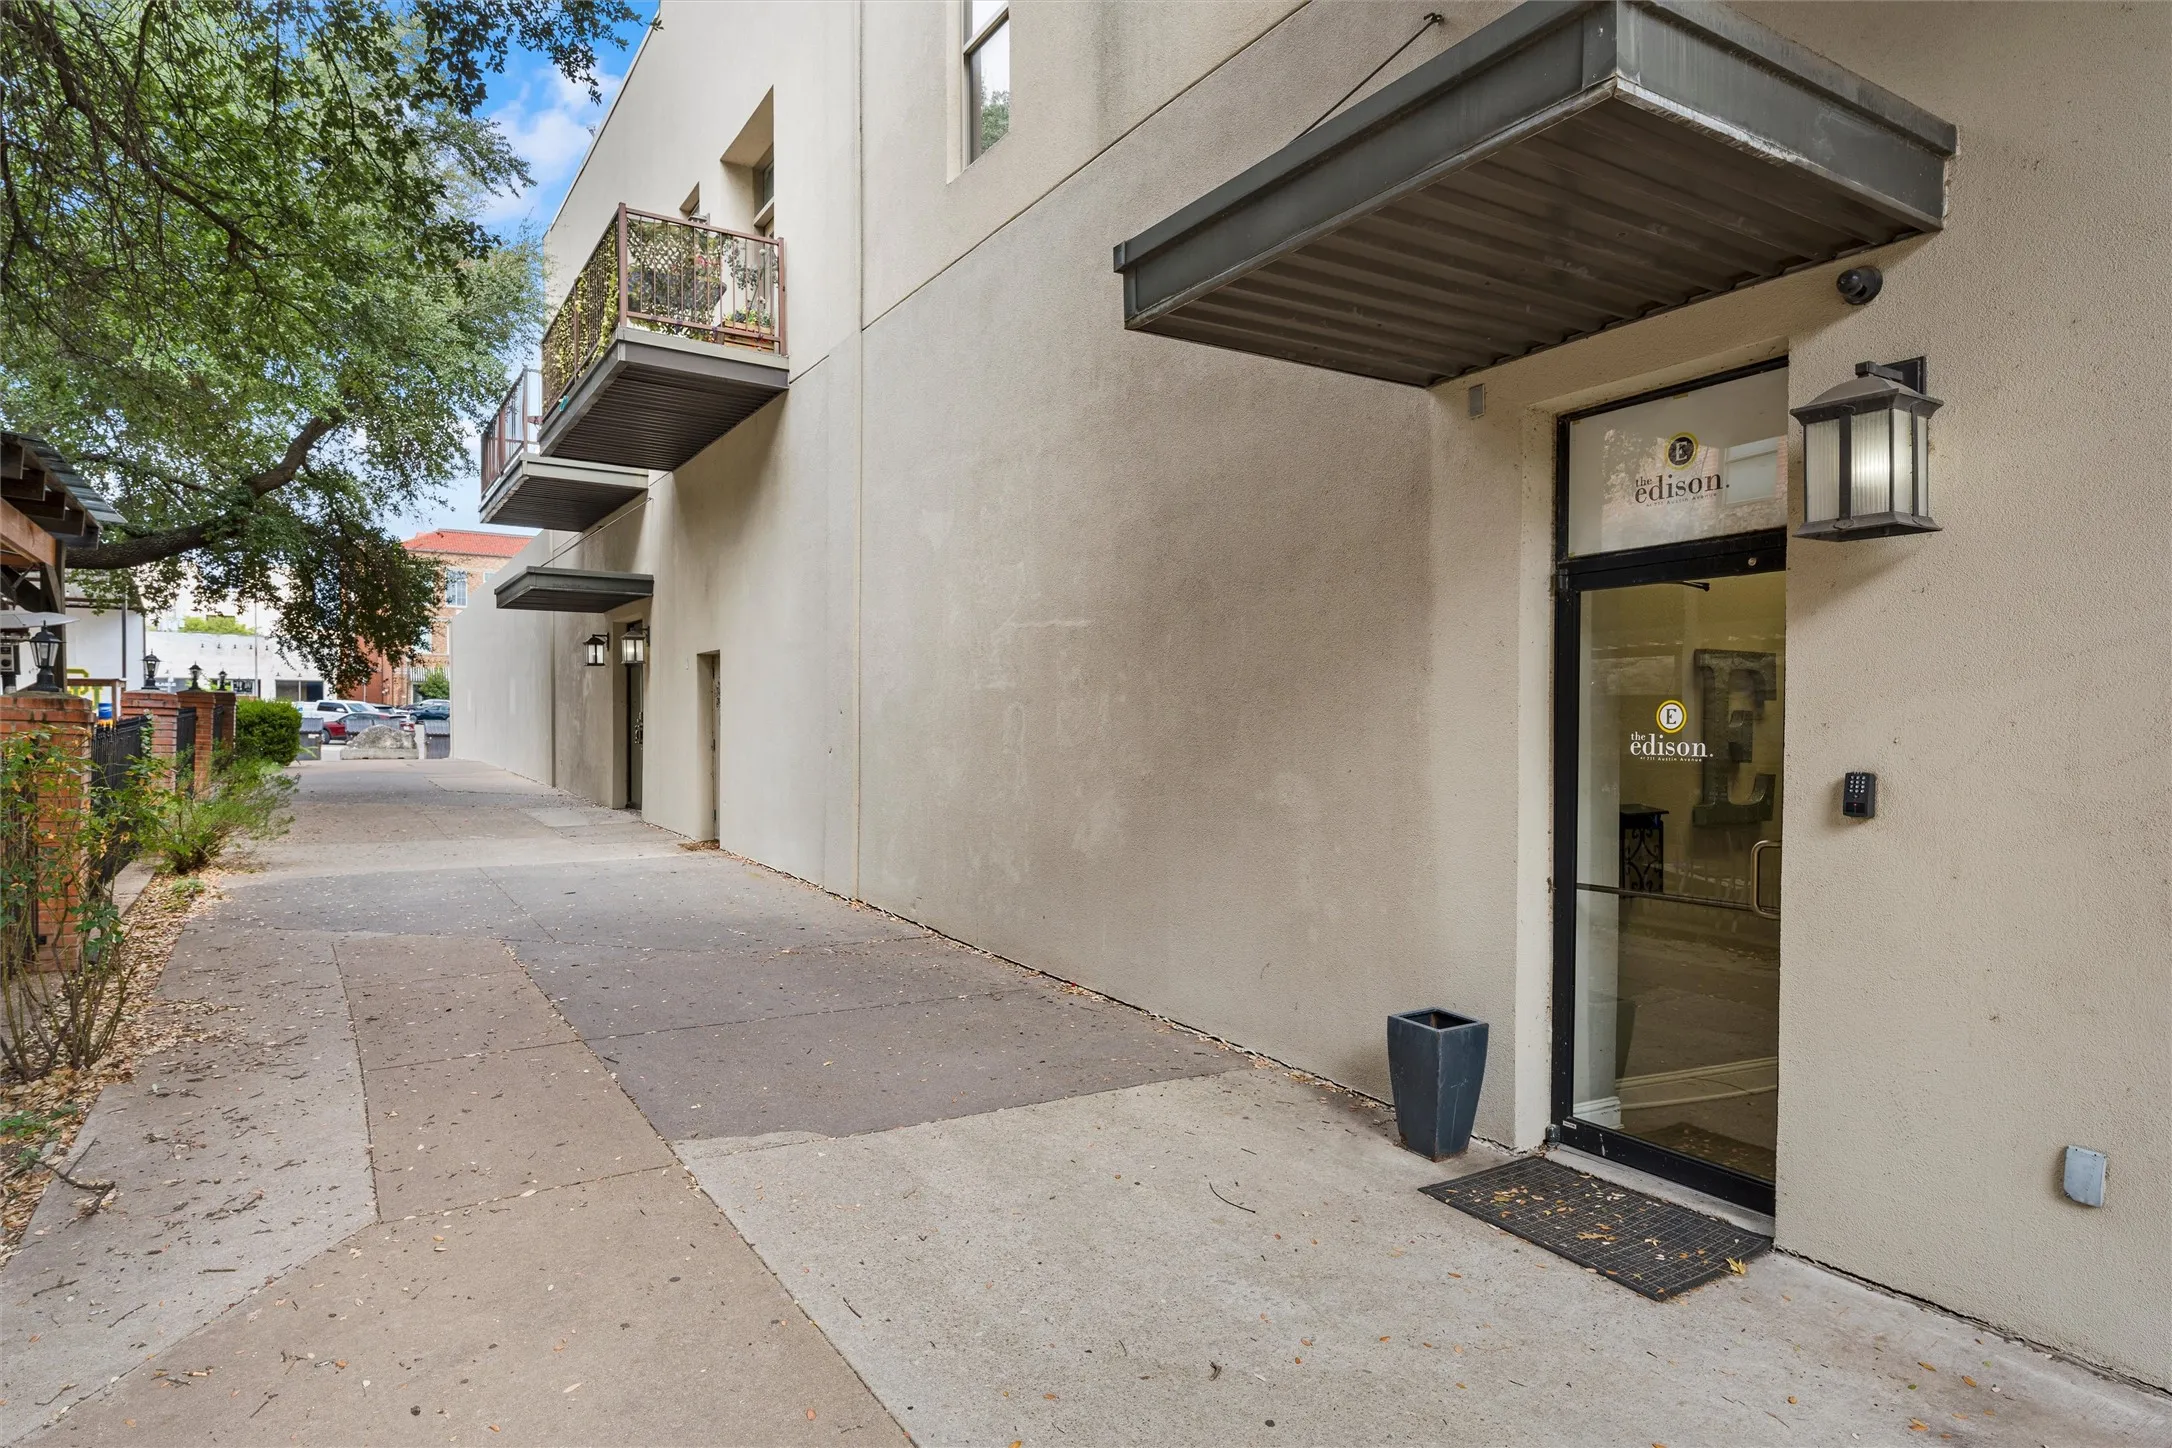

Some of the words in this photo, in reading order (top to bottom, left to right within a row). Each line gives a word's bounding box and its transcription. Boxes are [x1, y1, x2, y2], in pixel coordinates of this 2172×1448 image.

[1675, 440, 1688, 462] E
[1635, 476, 1653, 488] the
[1635, 473, 1730, 504] edison.
[1665, 708, 1677, 725] E
[1630, 731, 1646, 741] the
[1630, 733, 1714, 758] edison.
